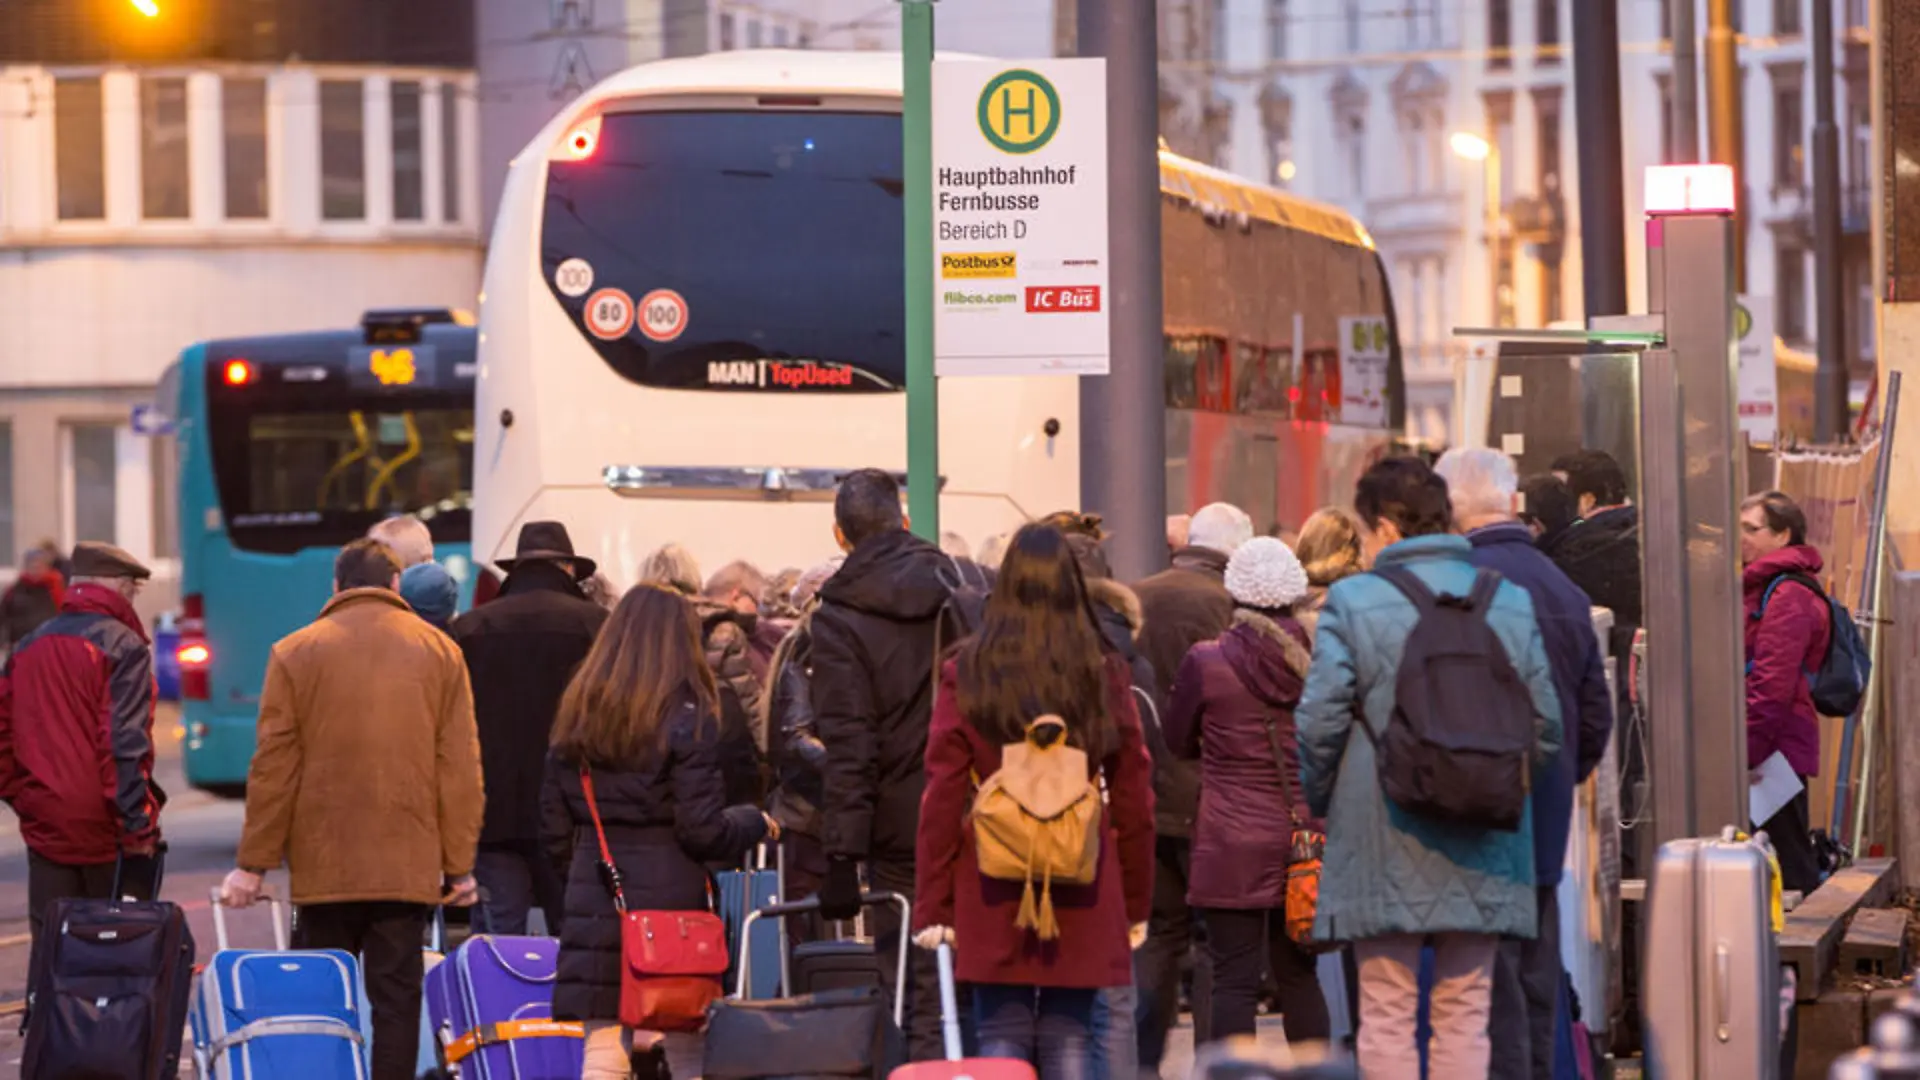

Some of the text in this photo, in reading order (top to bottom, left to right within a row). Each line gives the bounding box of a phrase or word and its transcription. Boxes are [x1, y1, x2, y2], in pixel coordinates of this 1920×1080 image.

[1003, 88, 1035, 136] H
[939, 165, 1076, 190] Hauptbahnhof
[939, 192, 1039, 211] Fernbusse
[939, 219, 1027, 240] Bereich D
[942, 255, 999, 269] Postbus
[562, 268, 589, 287] 100
[944, 291, 1017, 305] flibco.com
[1033, 290, 1095, 307] IC Bus
[599, 302, 622, 321] 80
[647, 305, 677, 325] 100
[707, 361, 853, 388] MAN TopUsed
